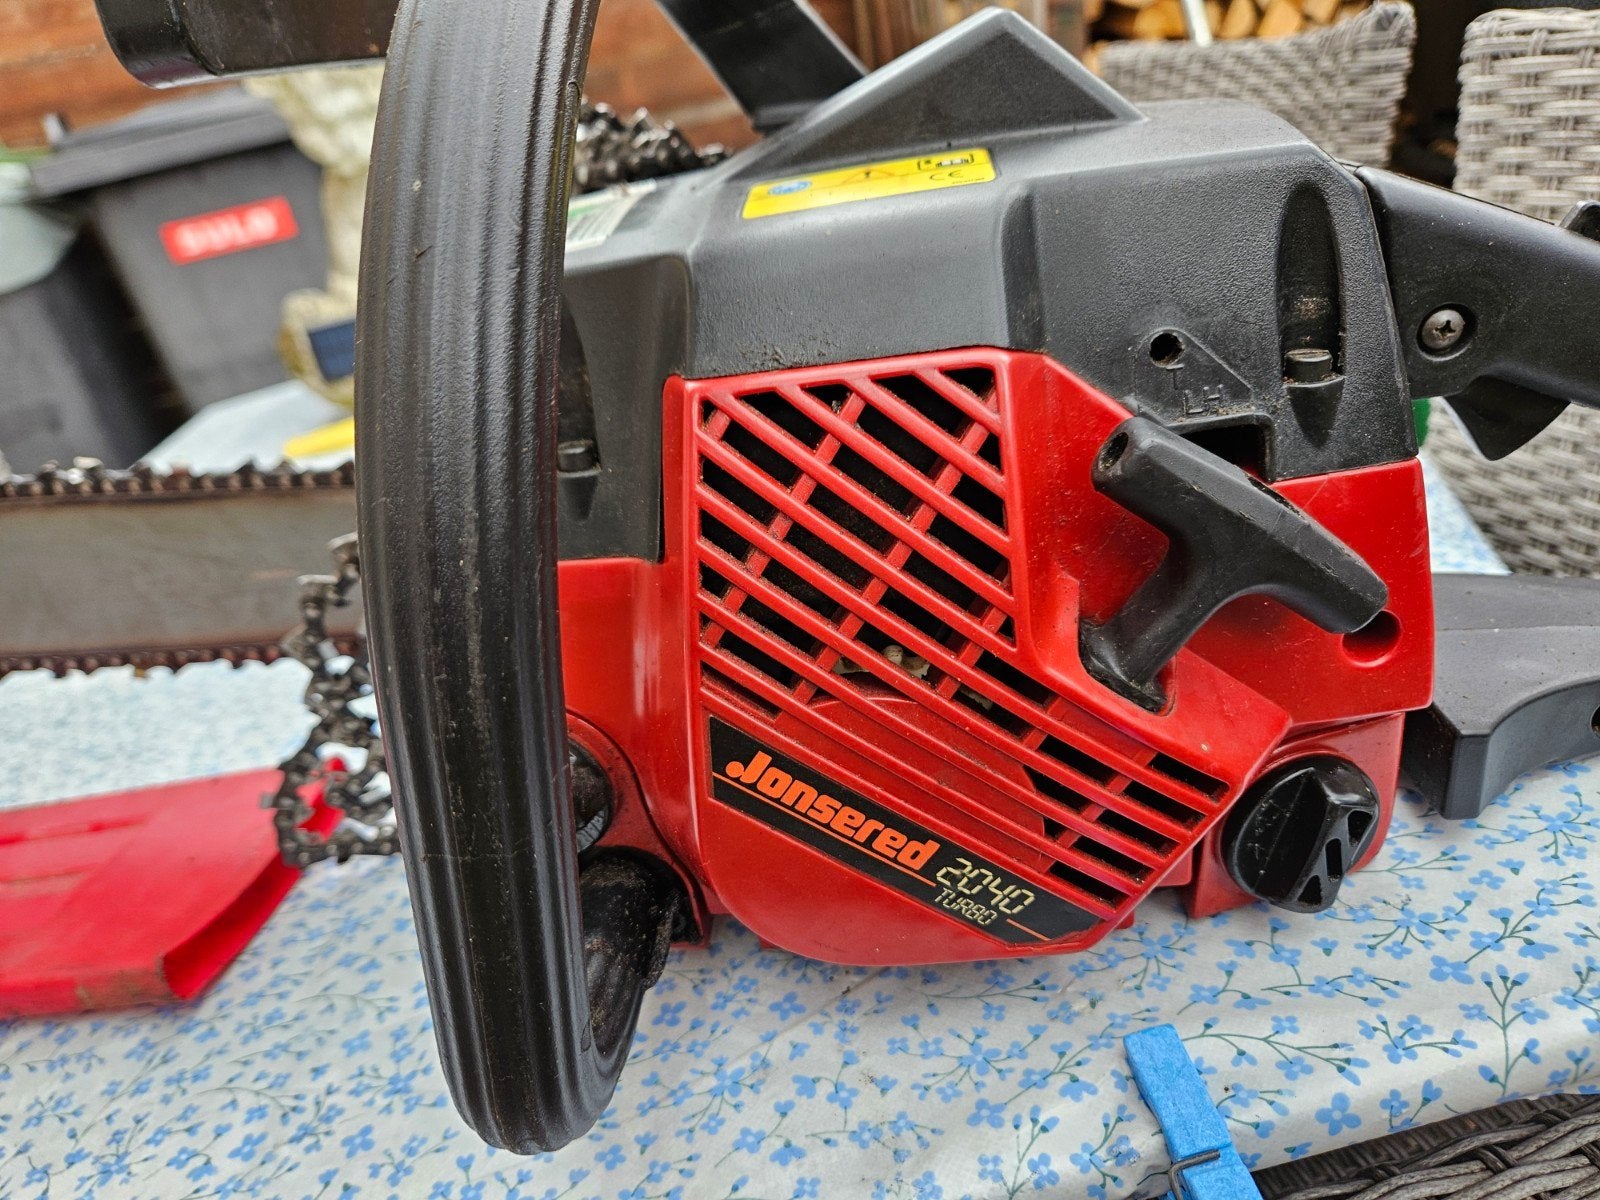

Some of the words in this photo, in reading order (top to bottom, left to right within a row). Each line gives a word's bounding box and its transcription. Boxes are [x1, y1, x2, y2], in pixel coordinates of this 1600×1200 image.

[725, 750, 941, 871] Jonsered
[934, 885, 998, 926] TURBO
[936, 857, 1035, 916] 2040
